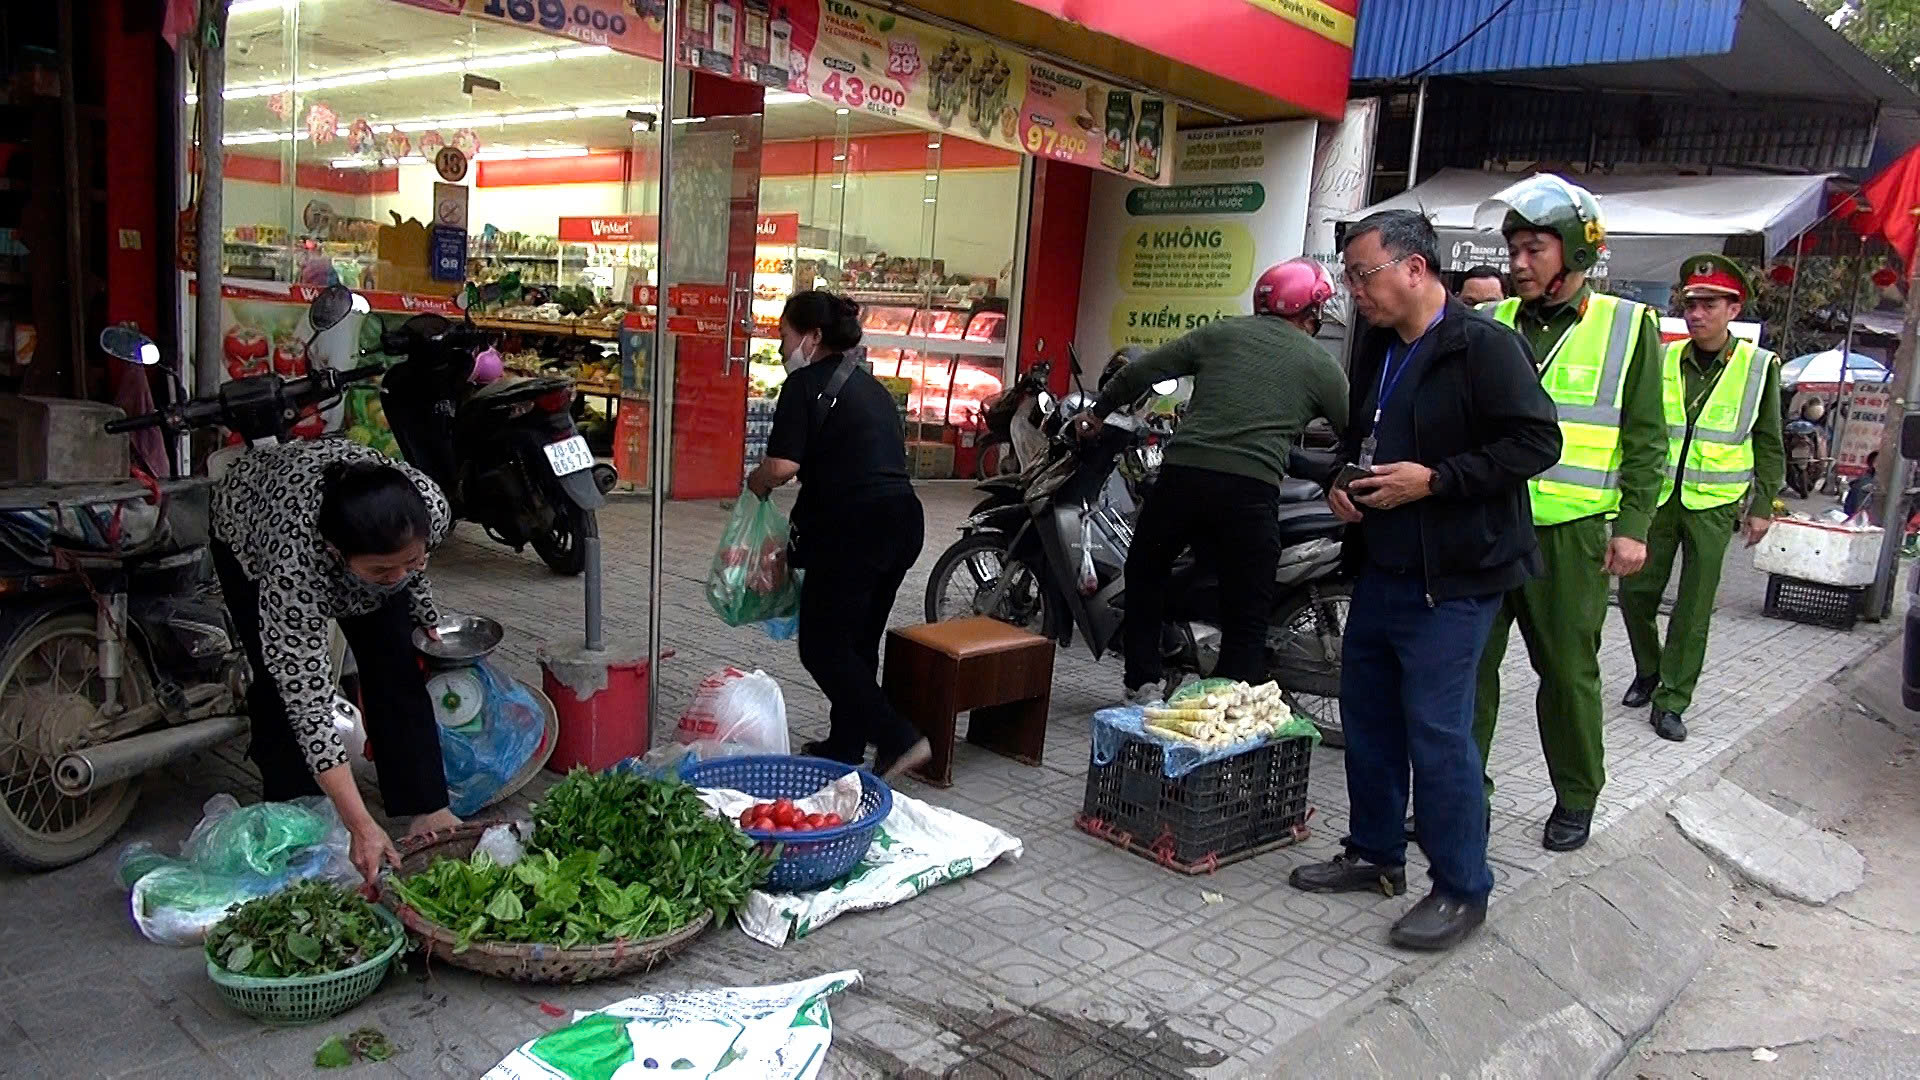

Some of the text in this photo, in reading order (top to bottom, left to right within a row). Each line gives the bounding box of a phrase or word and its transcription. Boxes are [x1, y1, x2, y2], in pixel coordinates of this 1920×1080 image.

[822, 72, 905, 108] 43.000
[1137, 225, 1223, 248] 4 KHÔNG
[1128, 311, 1138, 328] 3
[1141, 304, 1181, 329] KIỂM
